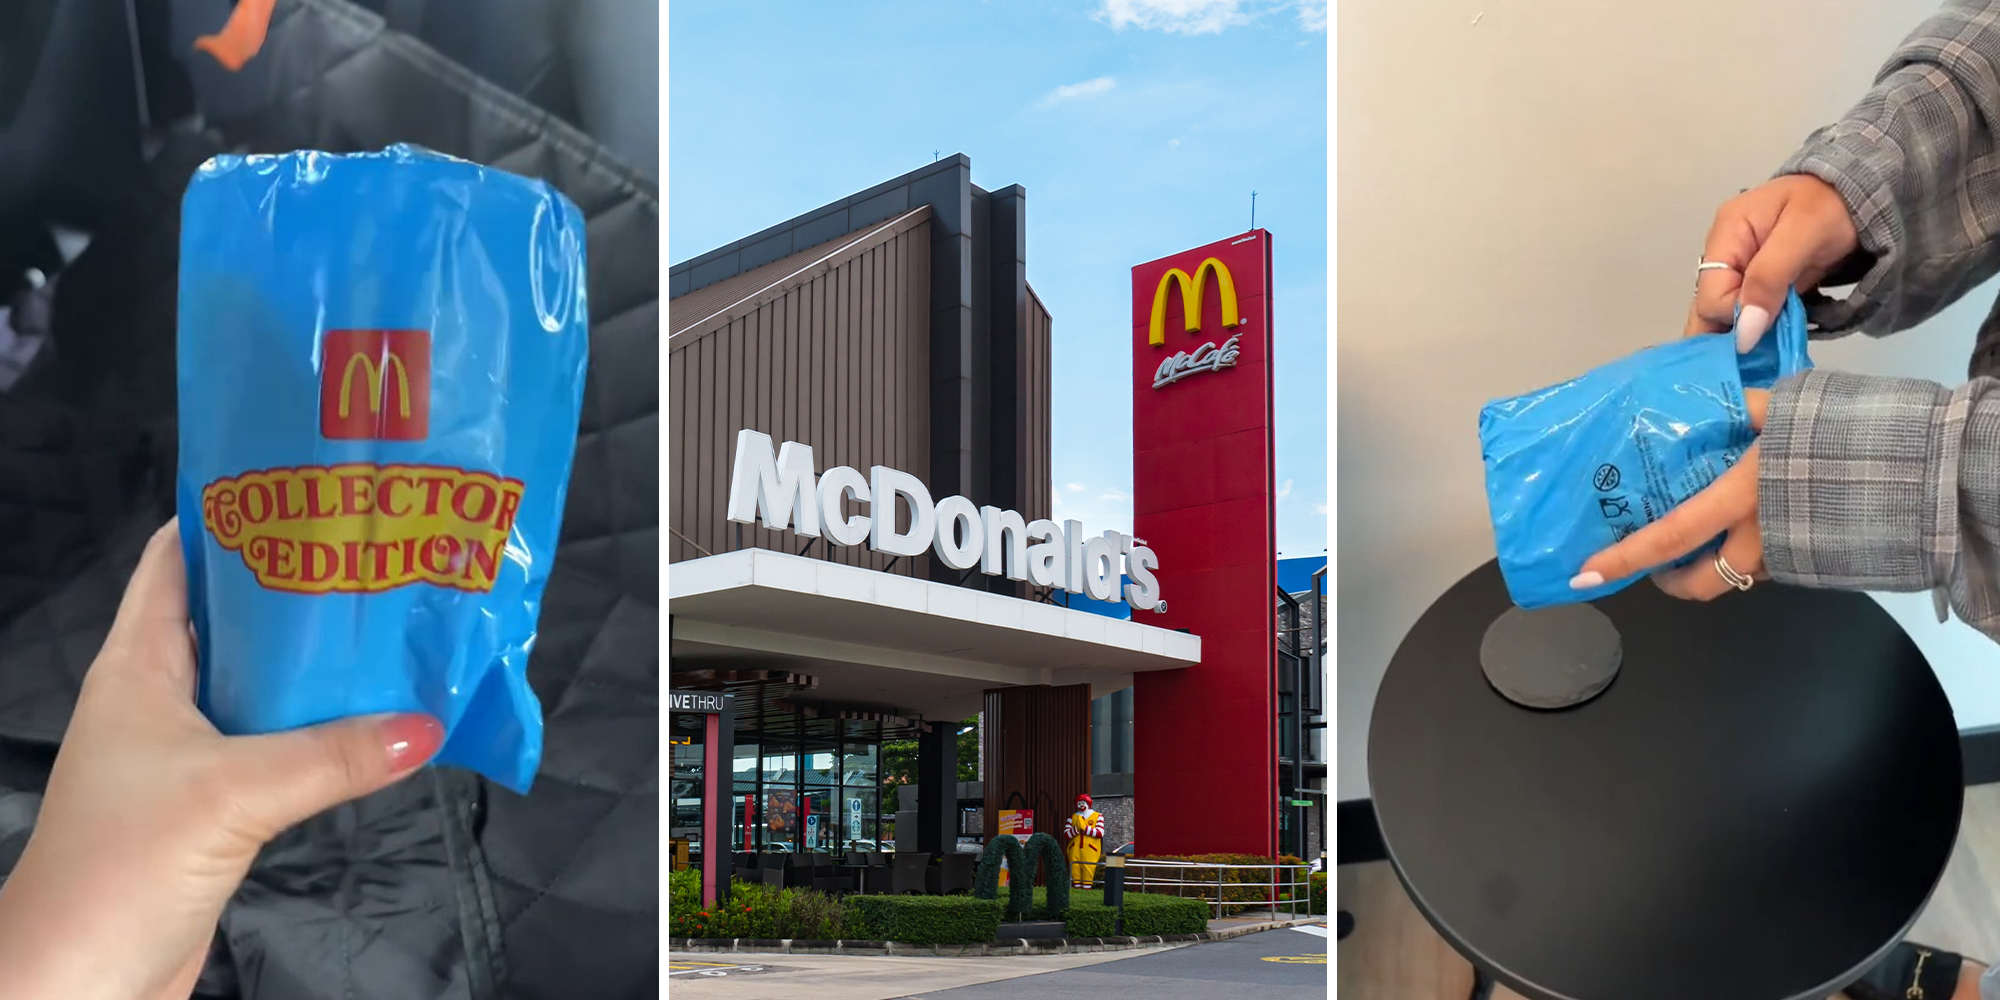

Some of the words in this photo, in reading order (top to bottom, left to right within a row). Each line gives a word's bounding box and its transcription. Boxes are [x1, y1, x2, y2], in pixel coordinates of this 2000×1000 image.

[1152, 337, 1241, 389] McCafé
[205, 474, 522, 540] COLLECTOR
[727, 428, 1160, 611] McDonald's
[249, 534, 507, 584] EDITION
